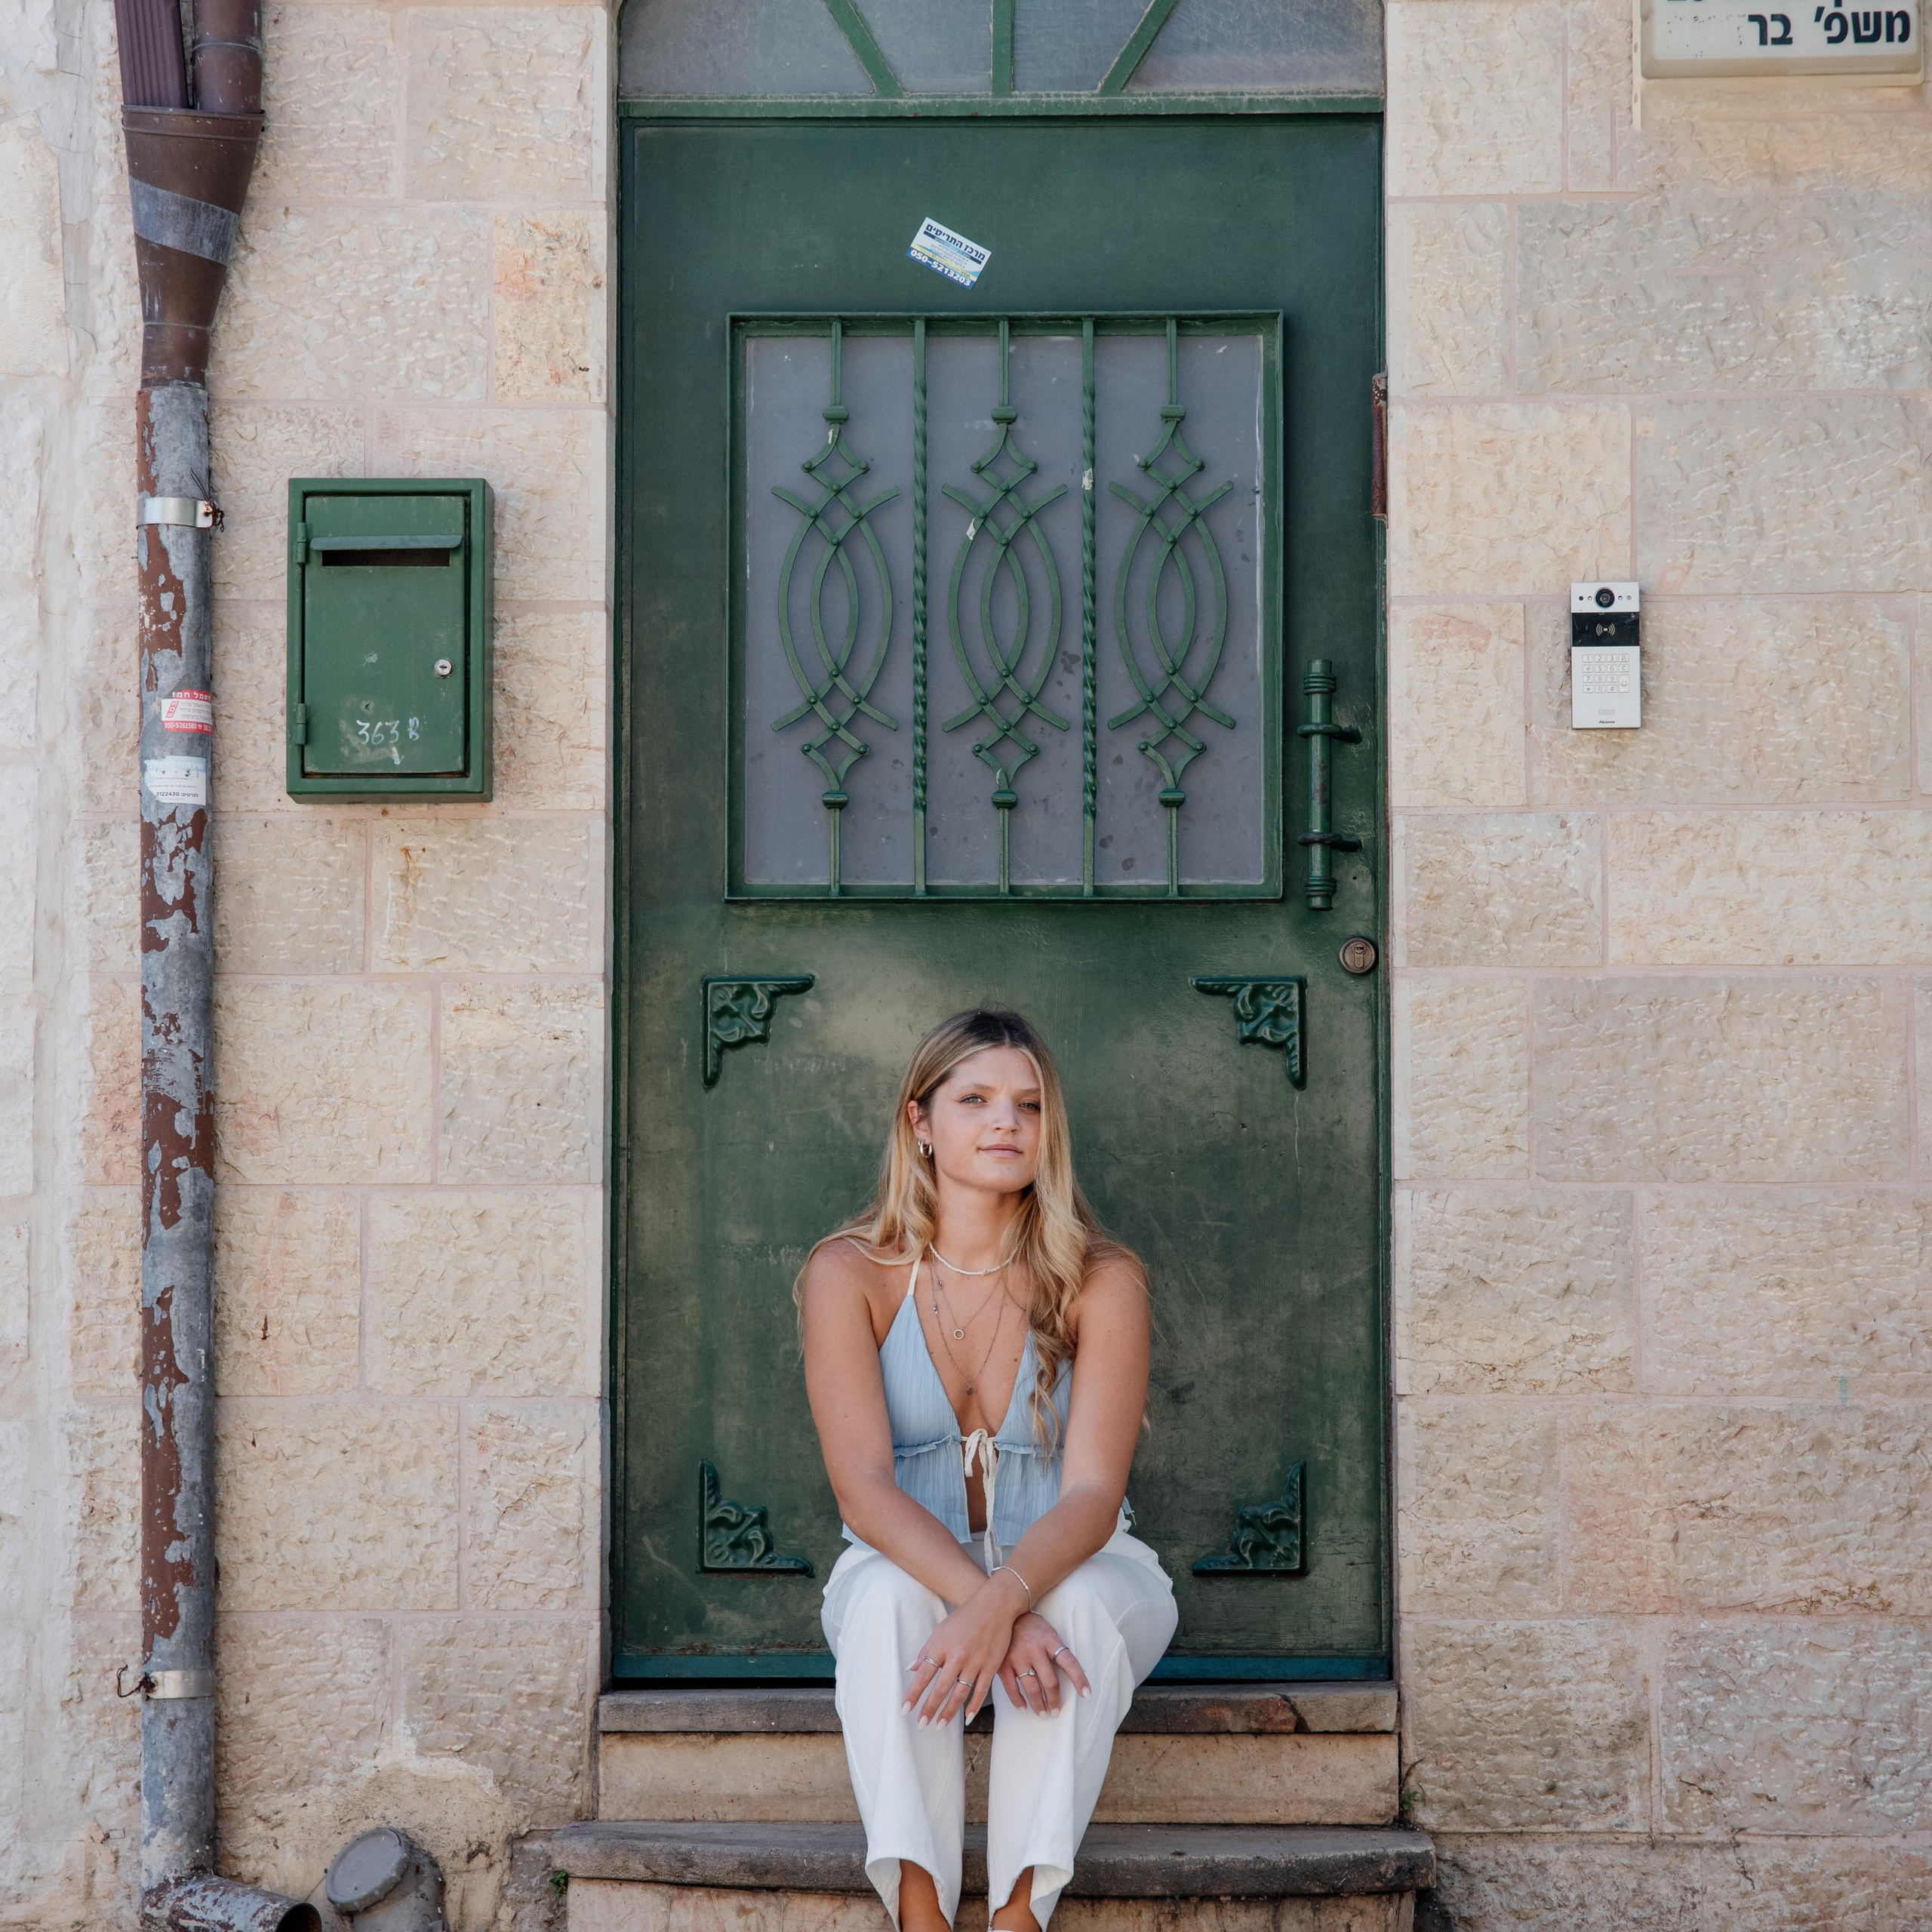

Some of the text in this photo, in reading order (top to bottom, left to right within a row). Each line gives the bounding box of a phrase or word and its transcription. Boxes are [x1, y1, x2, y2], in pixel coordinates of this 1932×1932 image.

[1747, 14, 1794, 46] בר
[925, 223, 964, 249] התריסים
[964, 244, 986, 261] מרכז
[910, 249, 971, 286] 050-5213203
[356, 719, 400, 746] 363
